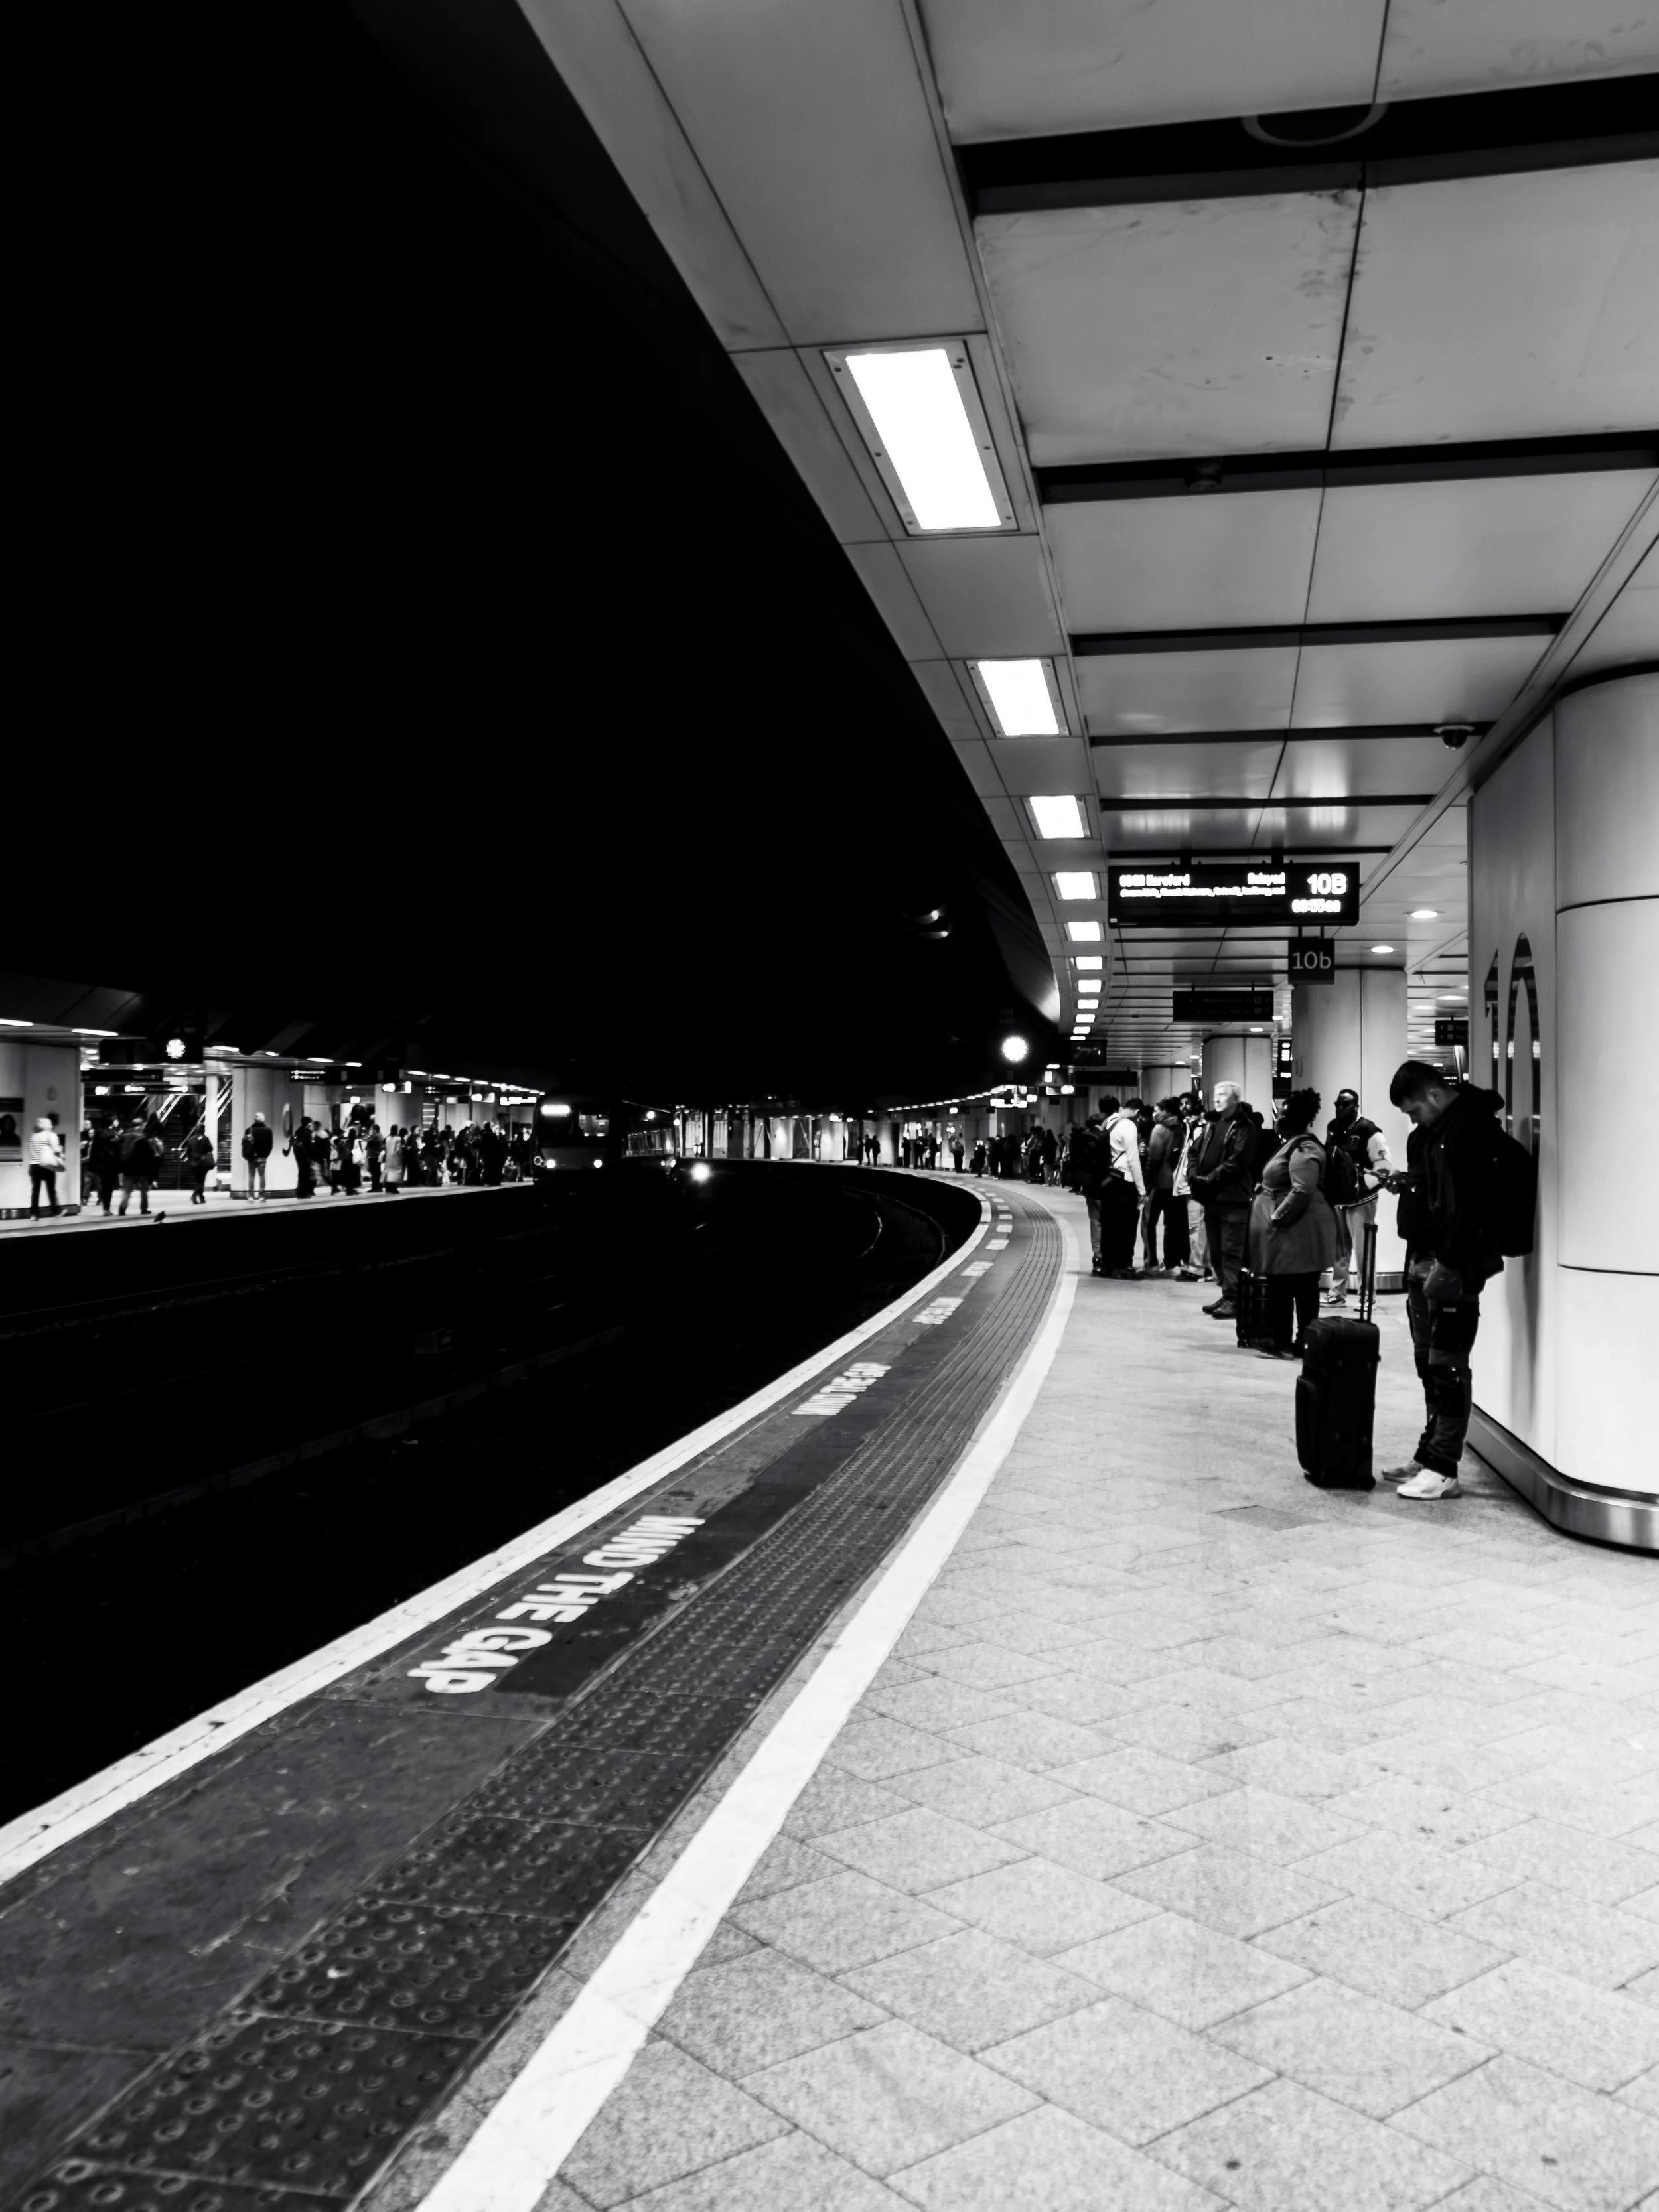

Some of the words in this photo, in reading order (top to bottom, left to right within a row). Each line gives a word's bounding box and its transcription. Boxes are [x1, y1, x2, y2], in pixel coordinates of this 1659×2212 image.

[1307, 872, 1347, 895] 10B
[1292, 951, 1331, 969] 10b
[1484, 932, 1541, 1171] 10
[583, 1515, 706, 1568] MIND
[494, 1571, 634, 1622] THE
[407, 1626, 553, 1694] GAP
